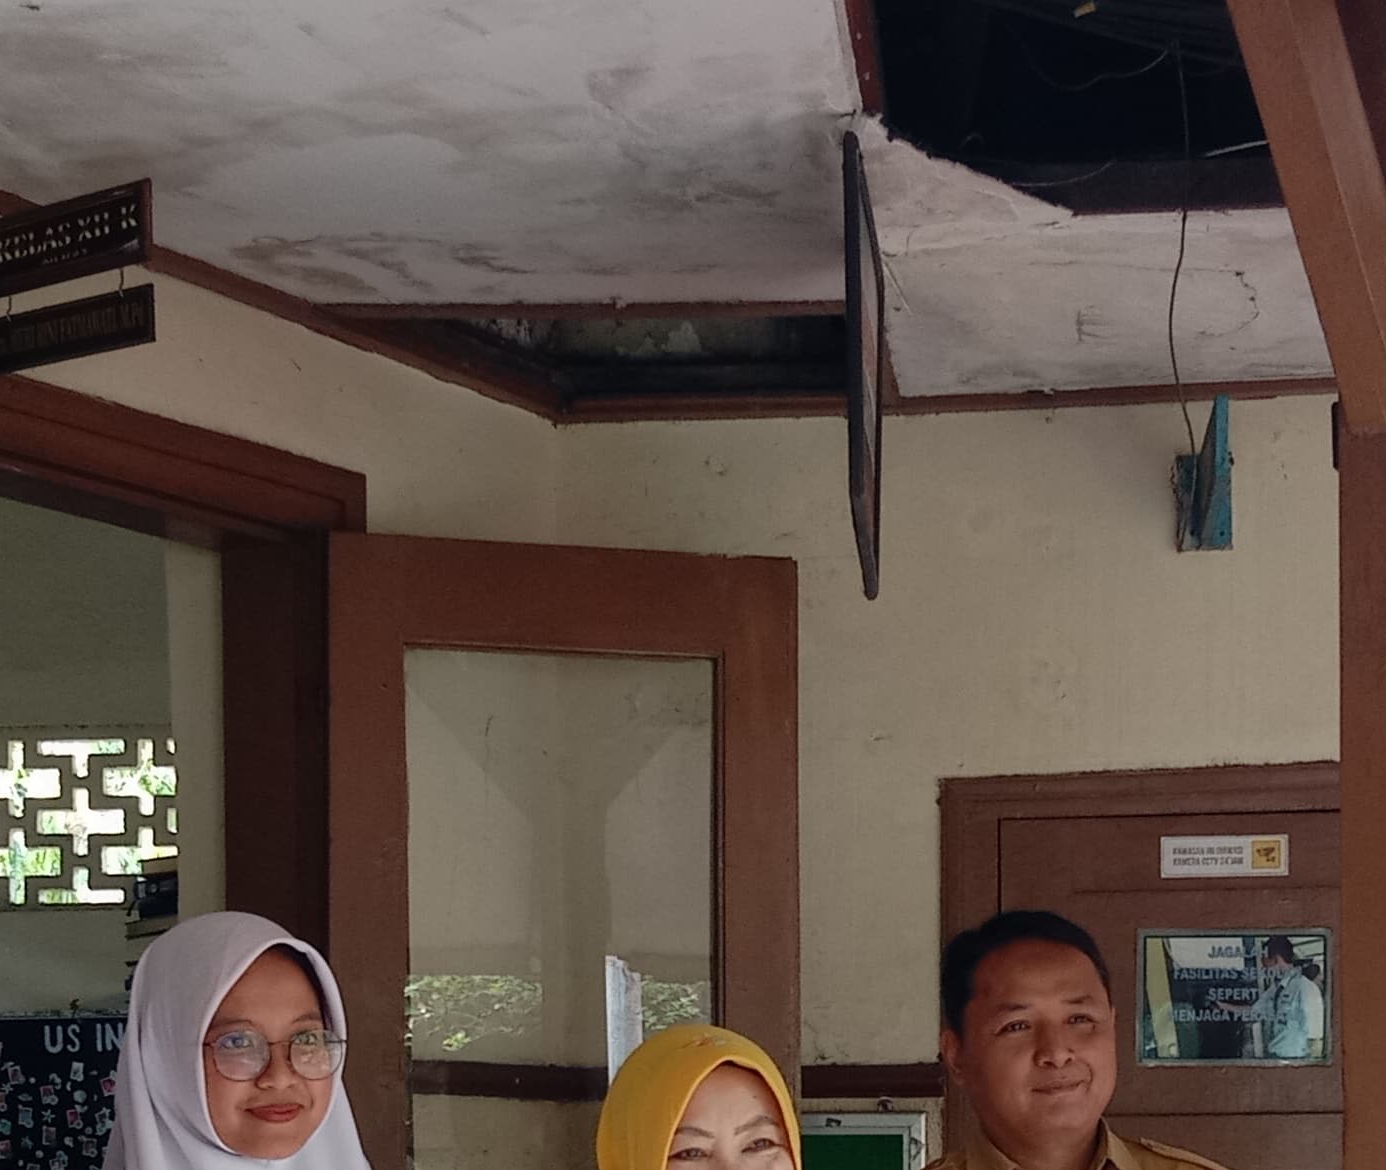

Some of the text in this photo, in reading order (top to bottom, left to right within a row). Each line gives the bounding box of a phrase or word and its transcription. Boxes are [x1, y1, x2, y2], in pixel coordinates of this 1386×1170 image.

[1173, 968, 1238, 981] FASILITAS
[1208, 987, 1259, 1002] SEPERT
[44, 1023, 81, 1053] US
